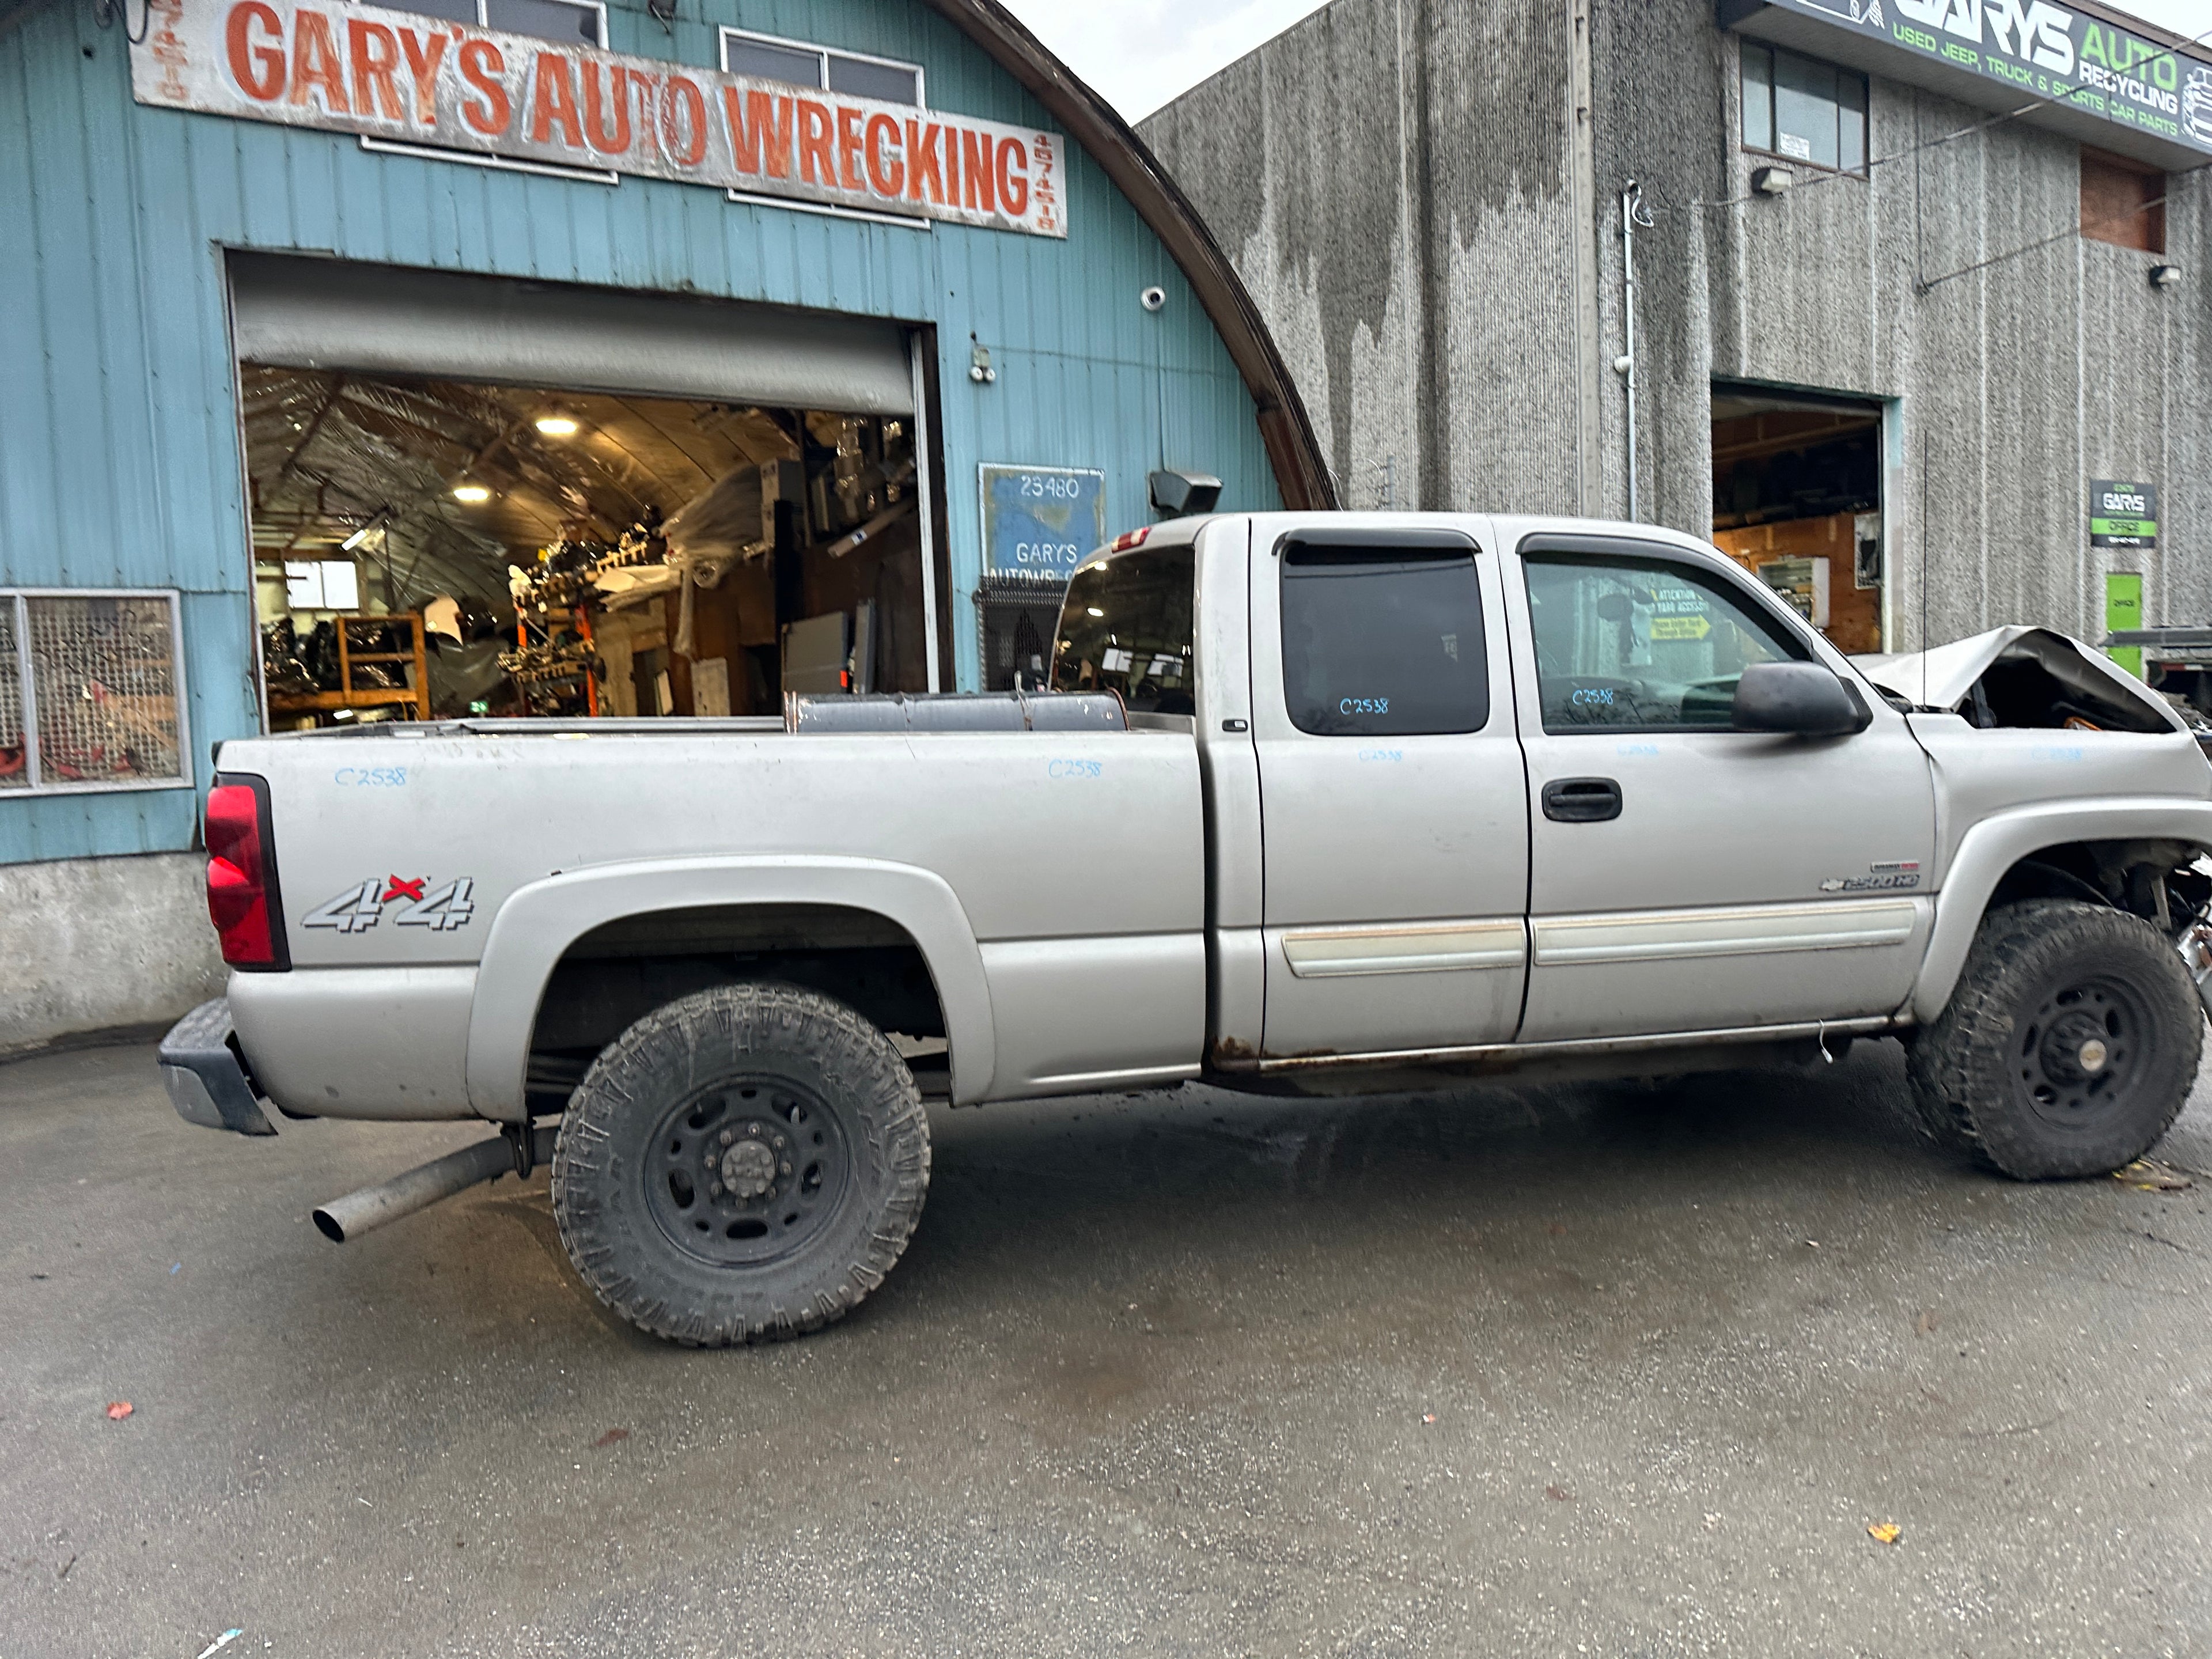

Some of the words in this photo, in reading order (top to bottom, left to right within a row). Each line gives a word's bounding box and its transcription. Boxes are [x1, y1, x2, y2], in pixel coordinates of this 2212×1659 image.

[2080, 22, 2177, 92] AUTO
[1892, 21, 1937, 52] USED
[1940, 41, 1982, 74] JEEP,
[1986, 55, 2033, 86] TRUCK
[2037, 74, 2048, 92] &
[2052, 80, 2105, 111] SPORTS
[2109, 99, 2135, 123] CAR
[2138, 110, 2178, 137] PARTS
[2079, 60, 2178, 115] RECYCLING
[226, 1, 511, 136] GARY'S
[532, 52, 706, 166] AUTO
[724, 86, 1028, 217] WRECKING
[1016, 542, 1078, 565] GARY'S
[1339, 697, 1390, 715] C2538
[1571, 689, 1613, 706] C2538
[334, 767, 407, 787] C2538
[1048, 757, 1103, 778] C2538
